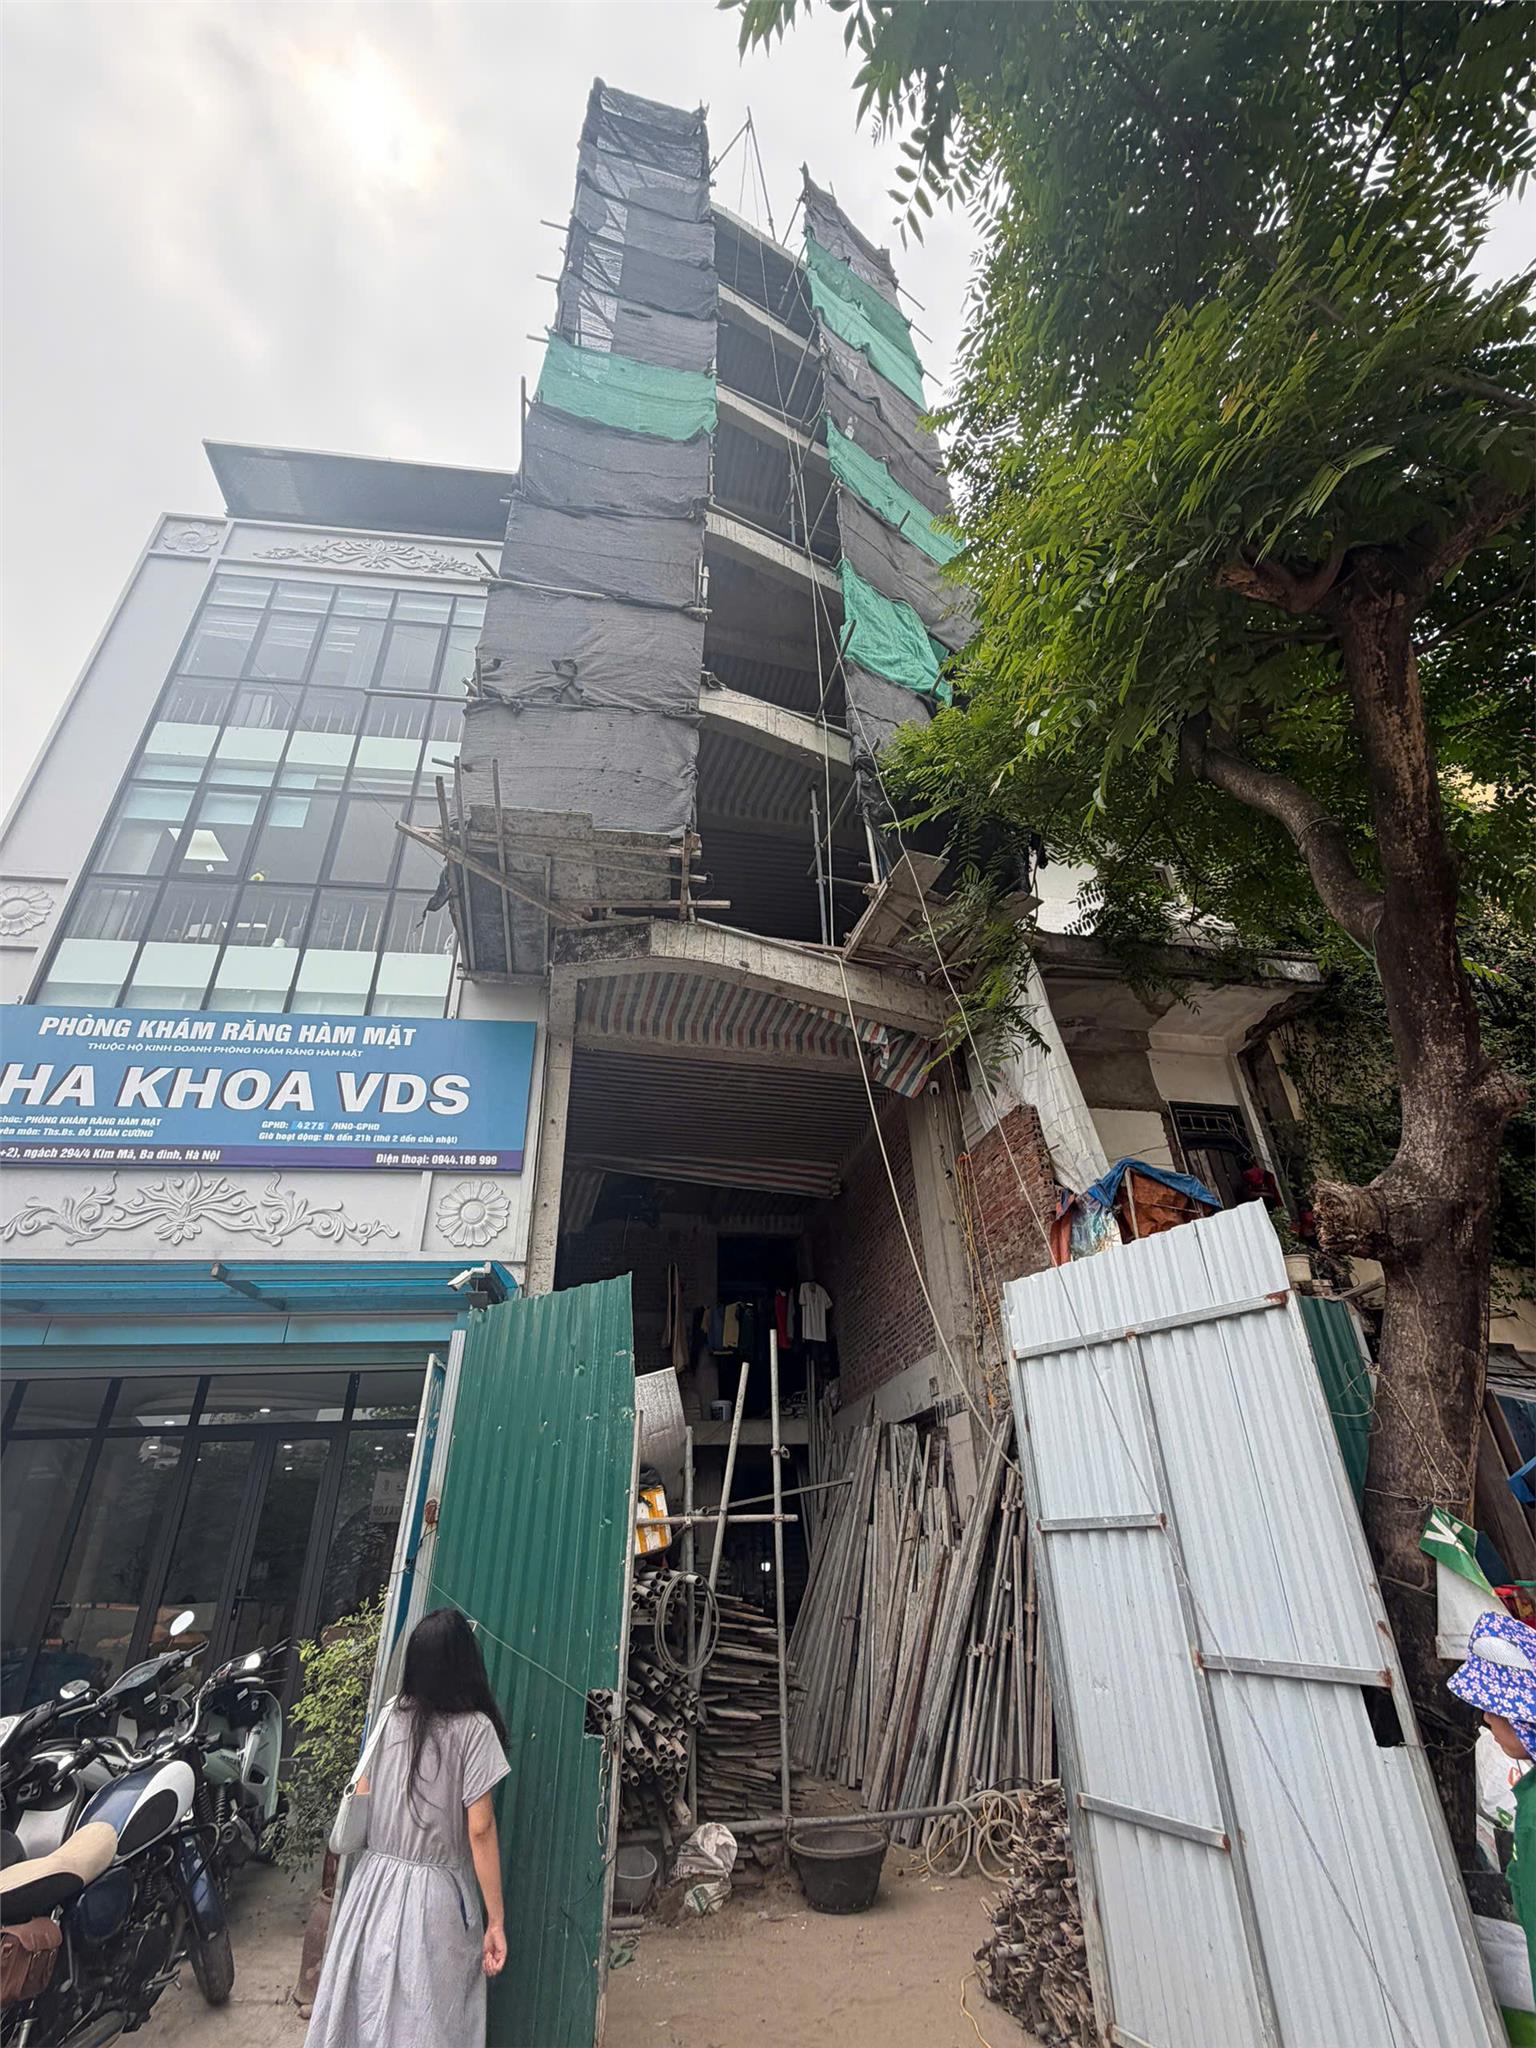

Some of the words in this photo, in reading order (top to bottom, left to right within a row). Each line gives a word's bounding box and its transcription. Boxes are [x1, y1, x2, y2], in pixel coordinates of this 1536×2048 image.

[38, 1013, 133, 1038] PHÒNG
[136, 1017, 216, 1040] KHÁM
[220, 1019, 293, 1042] RĂNG
[299, 1022, 356, 1044] HÀM
[362, 1024, 417, 1049] MẶT
[87, 1042, 126, 1052] THUỘC
[126, 1043, 143, 1052] HỘ
[144, 1044, 172, 1052] KINH
[173, 1045, 212, 1053] DOANH
[213, 1045, 251, 1054] PHÒNG
[252, 1046, 283, 1055] KHÁM
[285, 1047, 314, 1056] RĂNG
[316, 1048, 340, 1057] HÀM
[341, 1048, 363, 1059] MẶT
[115, 1065, 315, 1112] KHOA
[336, 1071, 471, 1115] VDS
[24, 1114, 58, 1125] PHÒNG
[59, 1115, 88, 1125] KHÁM
[117, 1116, 140, 1126] HÀM
[296, 1120, 325, 1131] 4275
[16, 1127, 42, 1137] môn:
[92, 1127, 121, 1138] XUÂN
[121, 1128, 155, 1138] CƯỜNG
[275, 1132, 295, 1142] hoạt
[296, 1132, 322, 1143] động:
[336, 1132, 354, 1142] đến
[354, 1133, 371, 1143] 21h
[392, 1134, 400, 1143] 2
[22, 1146, 58, 1160] ngách
[59, 1147, 92, 1159] 294/4
[92, 1148, 116, 1160] Kim
[139, 1148, 155, 1160] Ba
[185, 1149, 200, 1161] Hà
[201, 1149, 221, 1163] Nội
[376, 1153, 399, 1166] Điện
[401, 1153, 430, 1166] thoại:
[431, 1154, 477, 1166] 0944.186
[478, 1155, 498, 1166] 999
